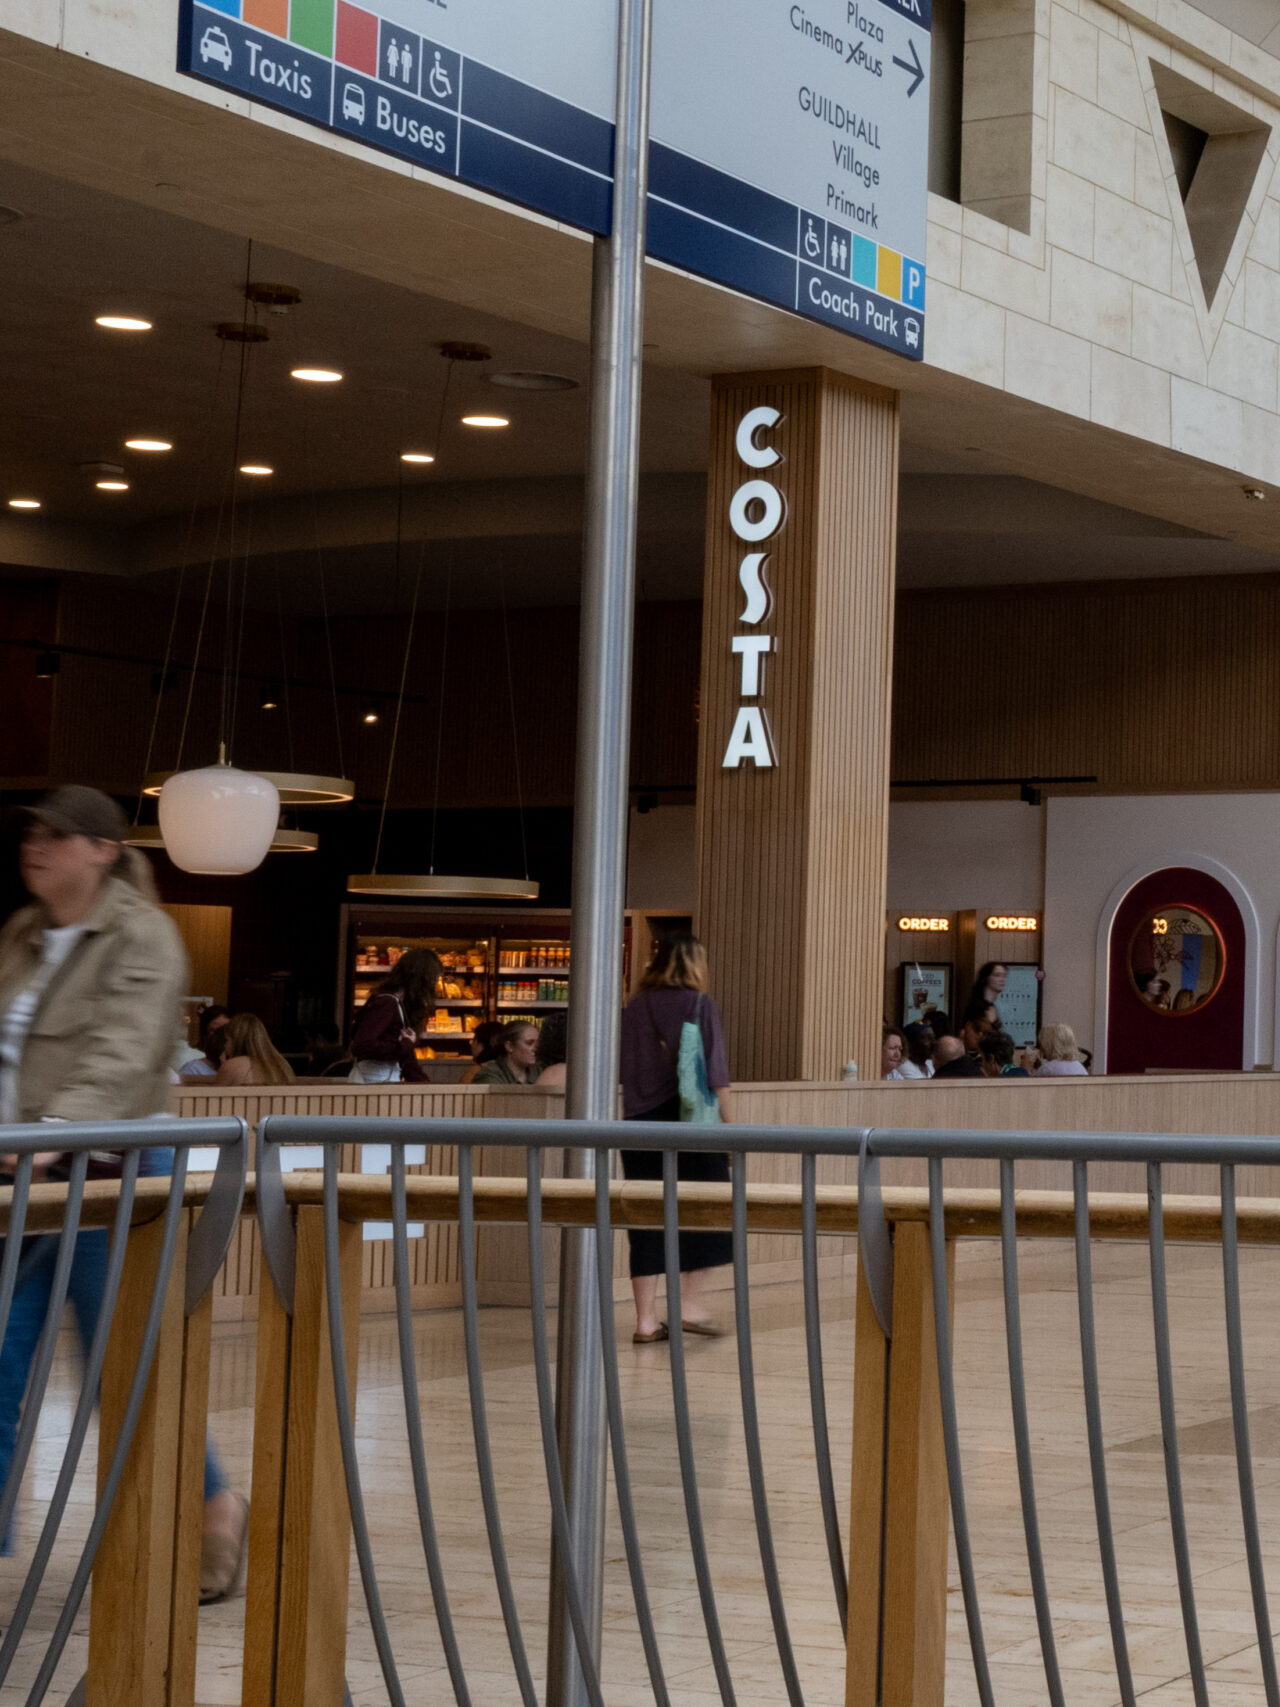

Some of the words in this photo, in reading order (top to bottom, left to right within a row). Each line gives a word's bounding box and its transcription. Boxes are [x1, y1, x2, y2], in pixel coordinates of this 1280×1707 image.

[790, 5, 843, 55] Cinema
[847, 1, 884, 43] Plaza
[245, 40, 312, 99] Taxis
[377, 97, 446, 154] Buses
[798, 86, 881, 150] GUILDHALL
[832, 140, 880, 188] Village
[827, 184, 879, 229] Primark
[809, 277, 859, 320] Coach
[866, 300, 899, 338] Park
[909, 267, 920, 299] P
[721, 406, 788, 769] COSTA
[899, 917, 949, 931] ORDER
[986, 916, 1037, 930] ORDER
